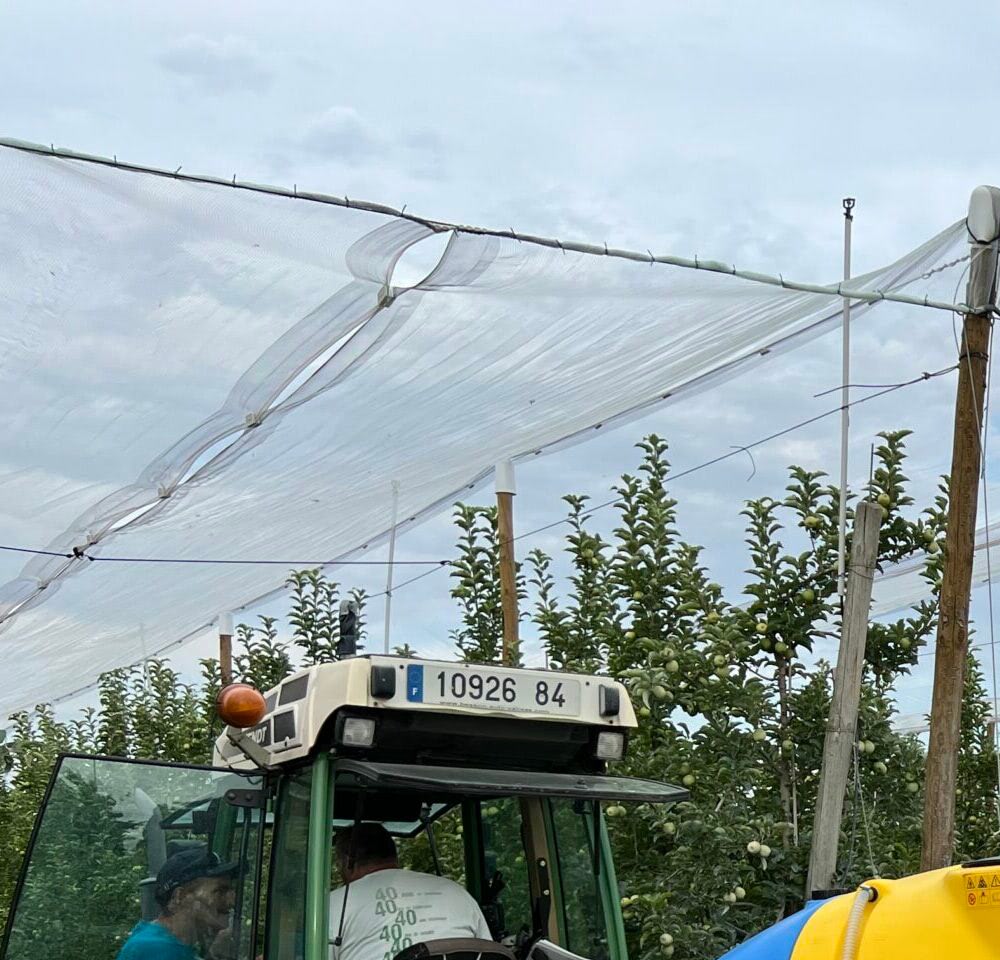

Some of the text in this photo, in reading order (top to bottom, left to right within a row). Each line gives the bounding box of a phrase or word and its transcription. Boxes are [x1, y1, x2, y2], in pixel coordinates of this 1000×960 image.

[411, 687, 418, 696] F
[437, 671, 516, 703] 10926
[535, 681, 566, 708] 84
[375, 887, 398, 901] 40
[375, 900, 397, 916] 40
[395, 909, 417, 926] 40
[379, 924, 402, 942] 40
